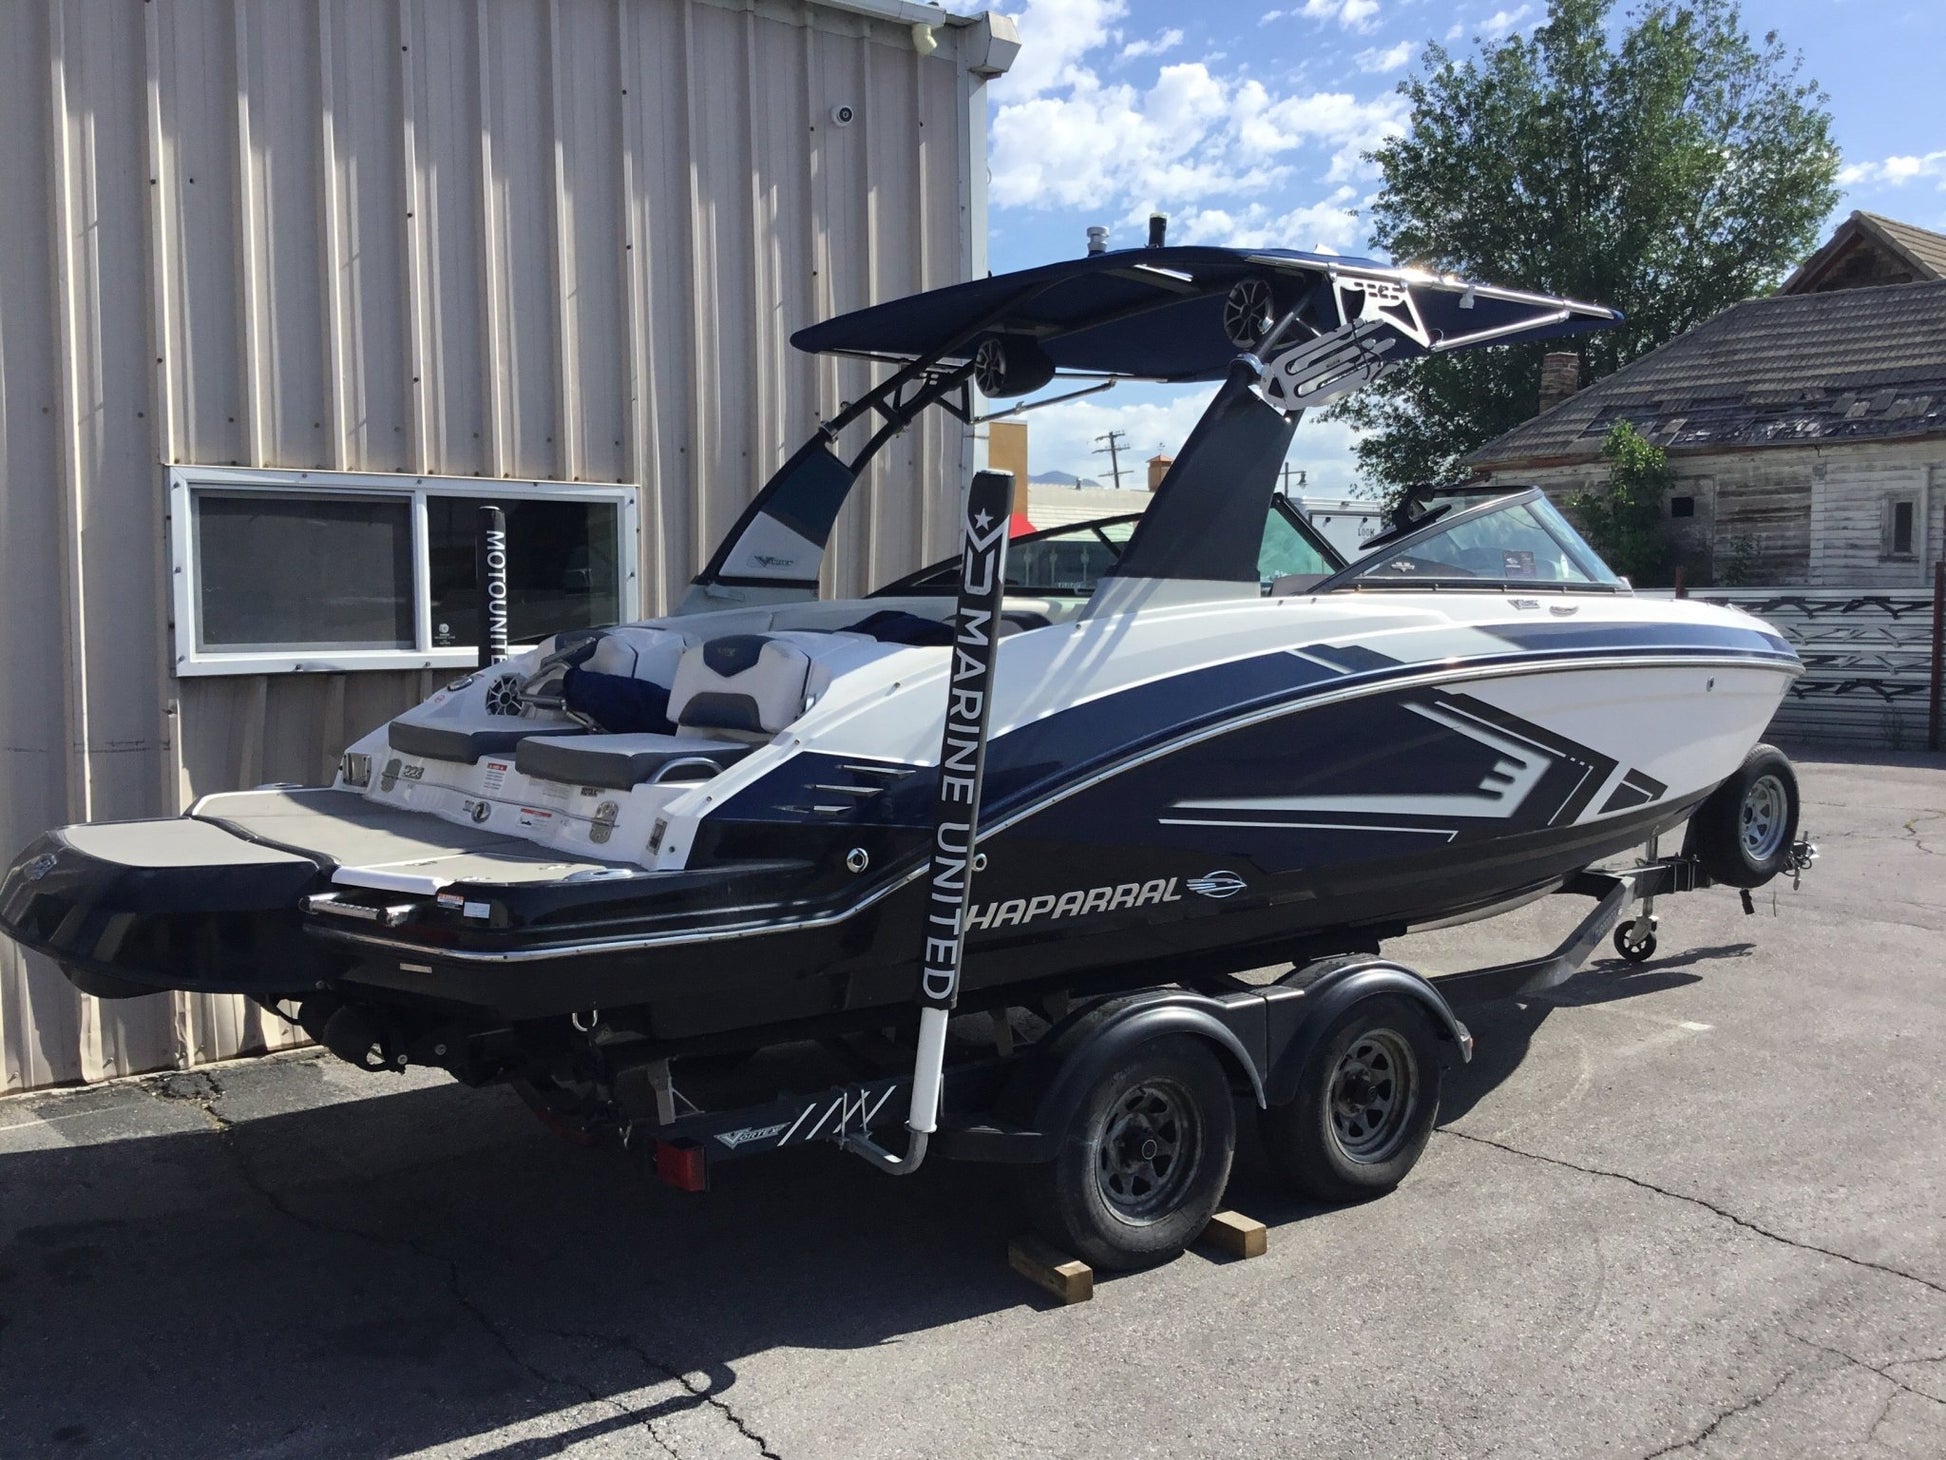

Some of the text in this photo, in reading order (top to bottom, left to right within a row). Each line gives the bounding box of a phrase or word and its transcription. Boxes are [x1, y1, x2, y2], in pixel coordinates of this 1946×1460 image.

[486, 530, 508, 666] MOTOUNITE
[923, 608, 992, 1000] MARINE UNITED
[962, 877, 1182, 931] HAPARRAL
